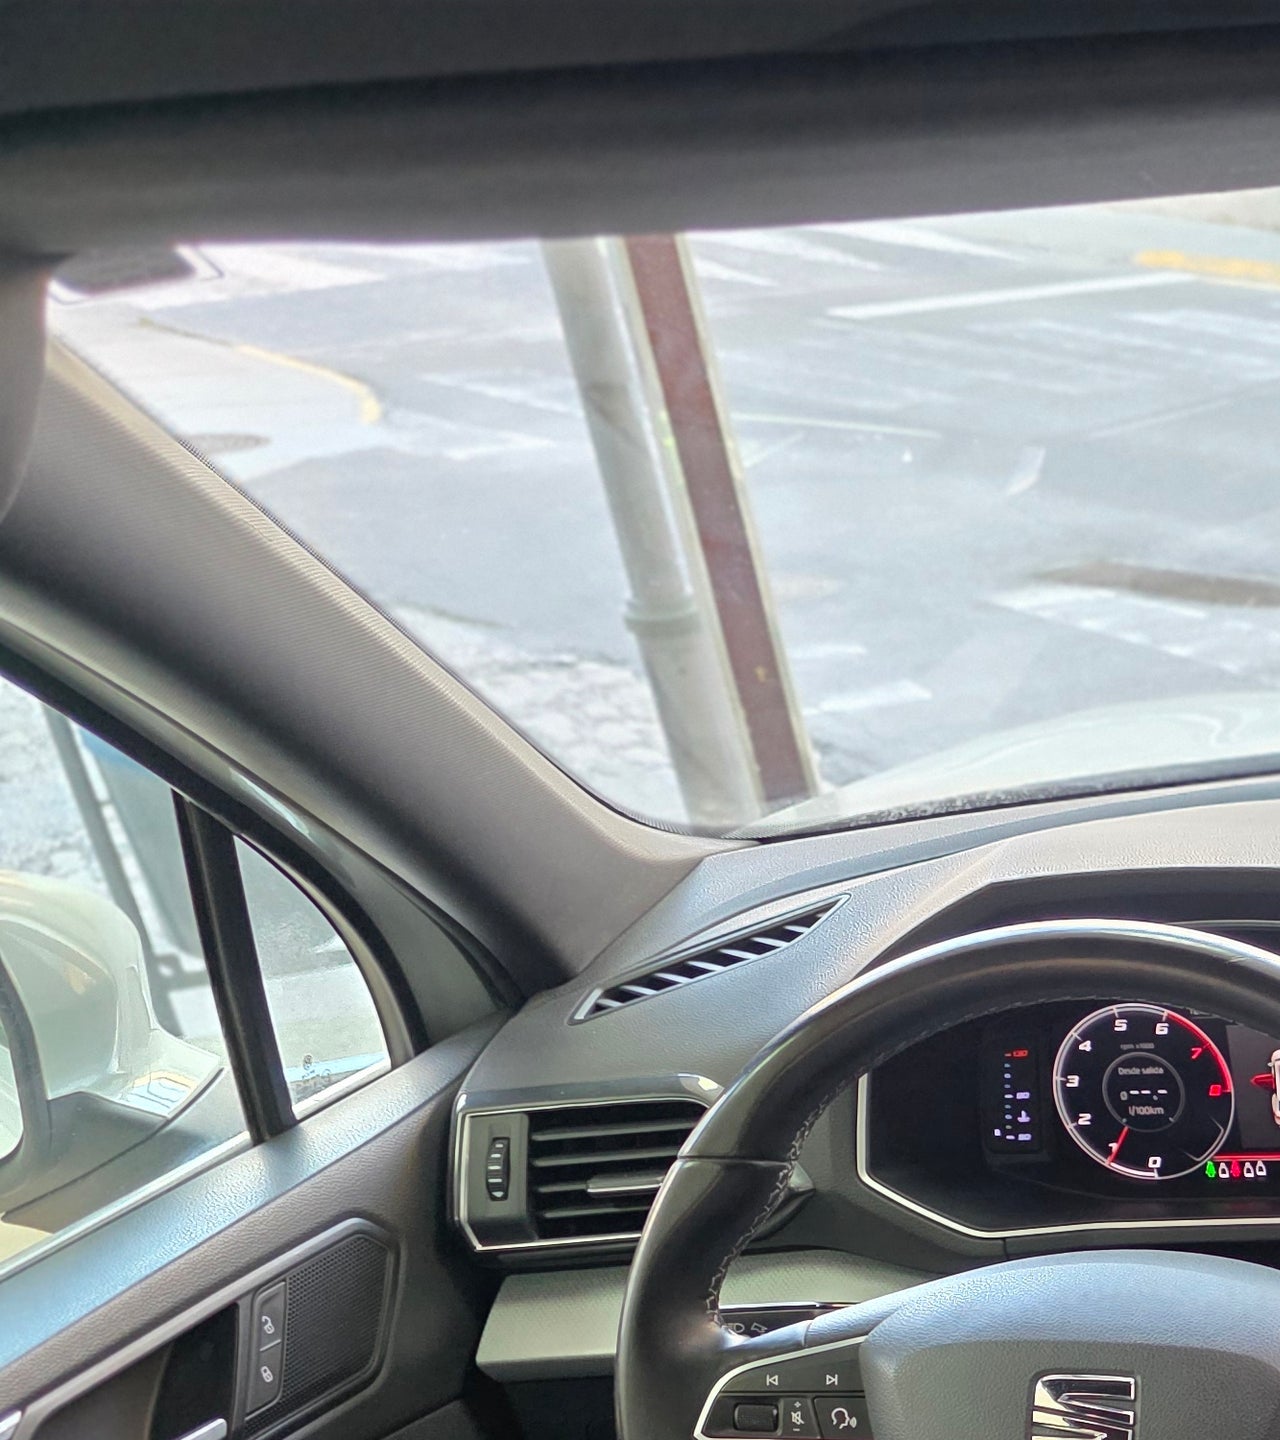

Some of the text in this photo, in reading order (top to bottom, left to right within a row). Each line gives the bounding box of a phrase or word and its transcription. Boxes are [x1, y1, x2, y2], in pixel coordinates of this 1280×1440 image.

[1114, 1020, 1127, 1031] 5
[1155, 1024, 1169, 1035] 6
[1078, 1040, 1092, 1052] 4
[1191, 1047, 1203, 1060] 7
[1066, 1075, 1079, 1087] 3
[1078, 1113, 1092, 1125] 2
[1147, 1156, 1162, 1168] 0
